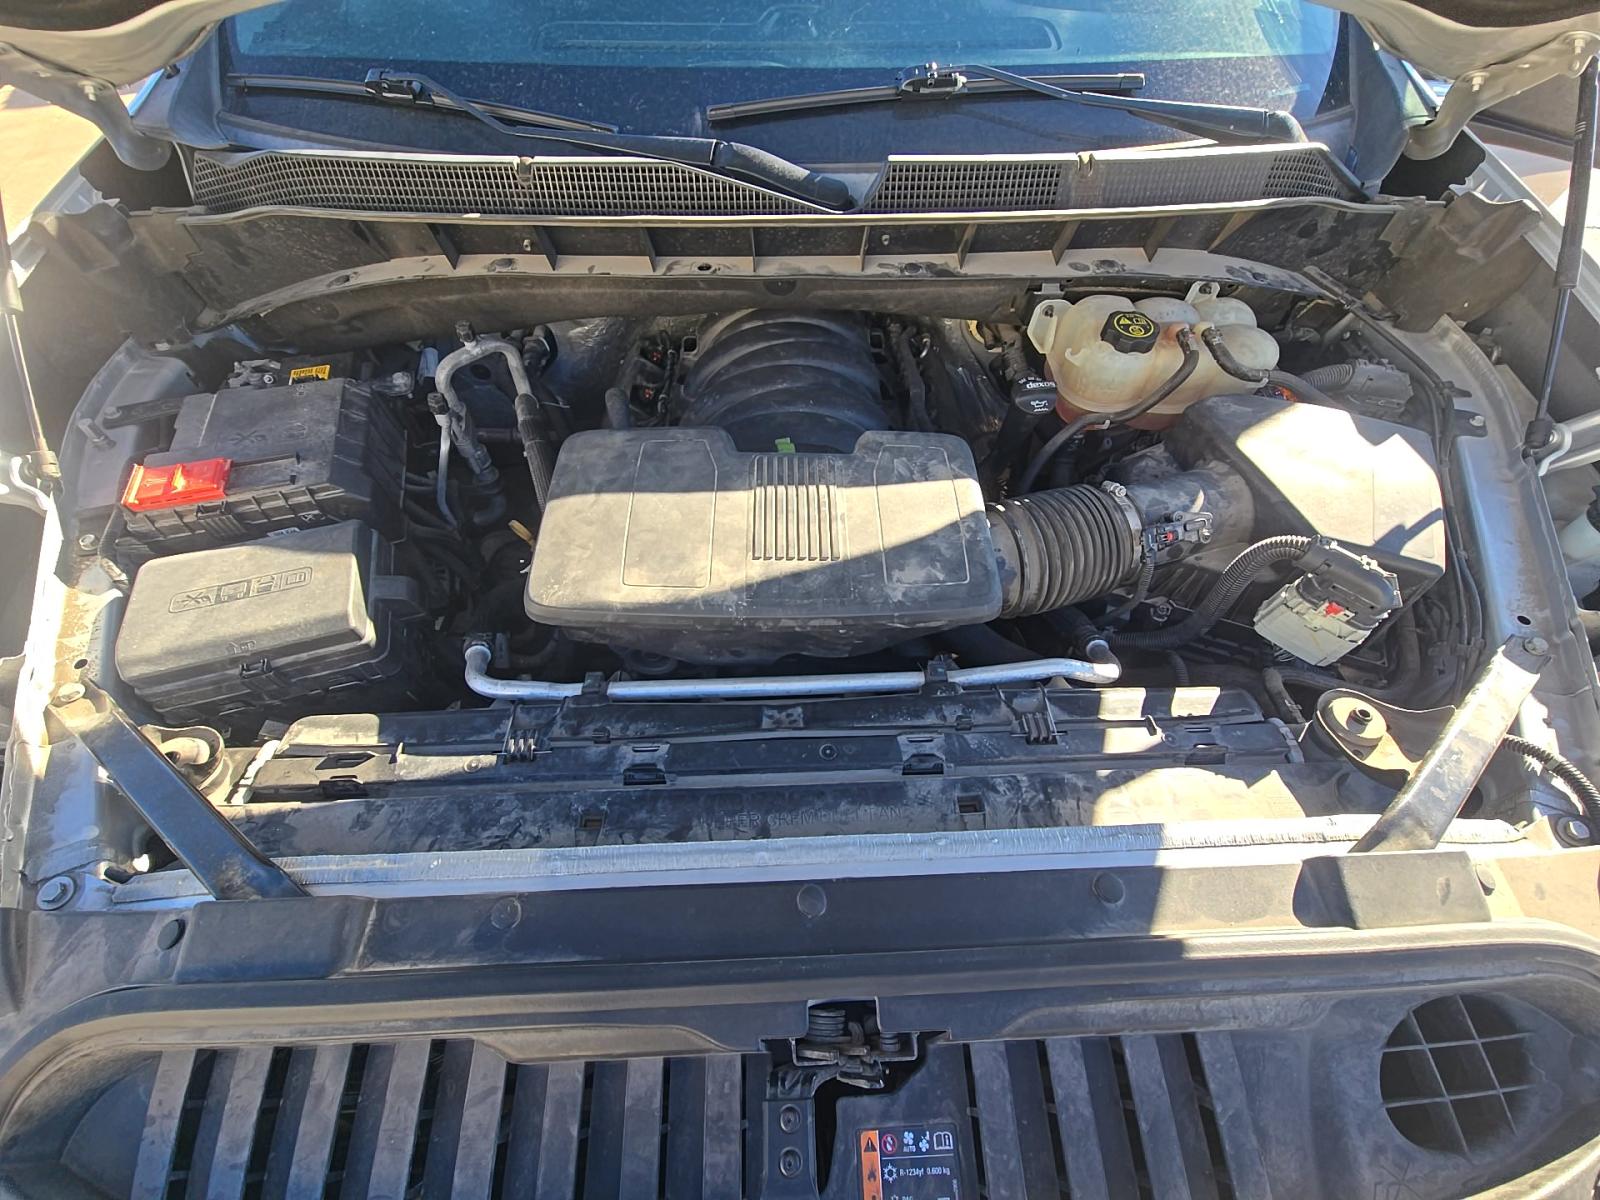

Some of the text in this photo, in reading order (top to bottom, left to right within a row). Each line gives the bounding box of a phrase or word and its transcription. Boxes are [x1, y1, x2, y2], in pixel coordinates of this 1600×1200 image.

[1026, 381, 1056, 389] dexos
[903, 1145, 916, 1153] AUTO
[899, 1167, 924, 1177] R-1234yf
[942, 1166, 951, 1176] kg
